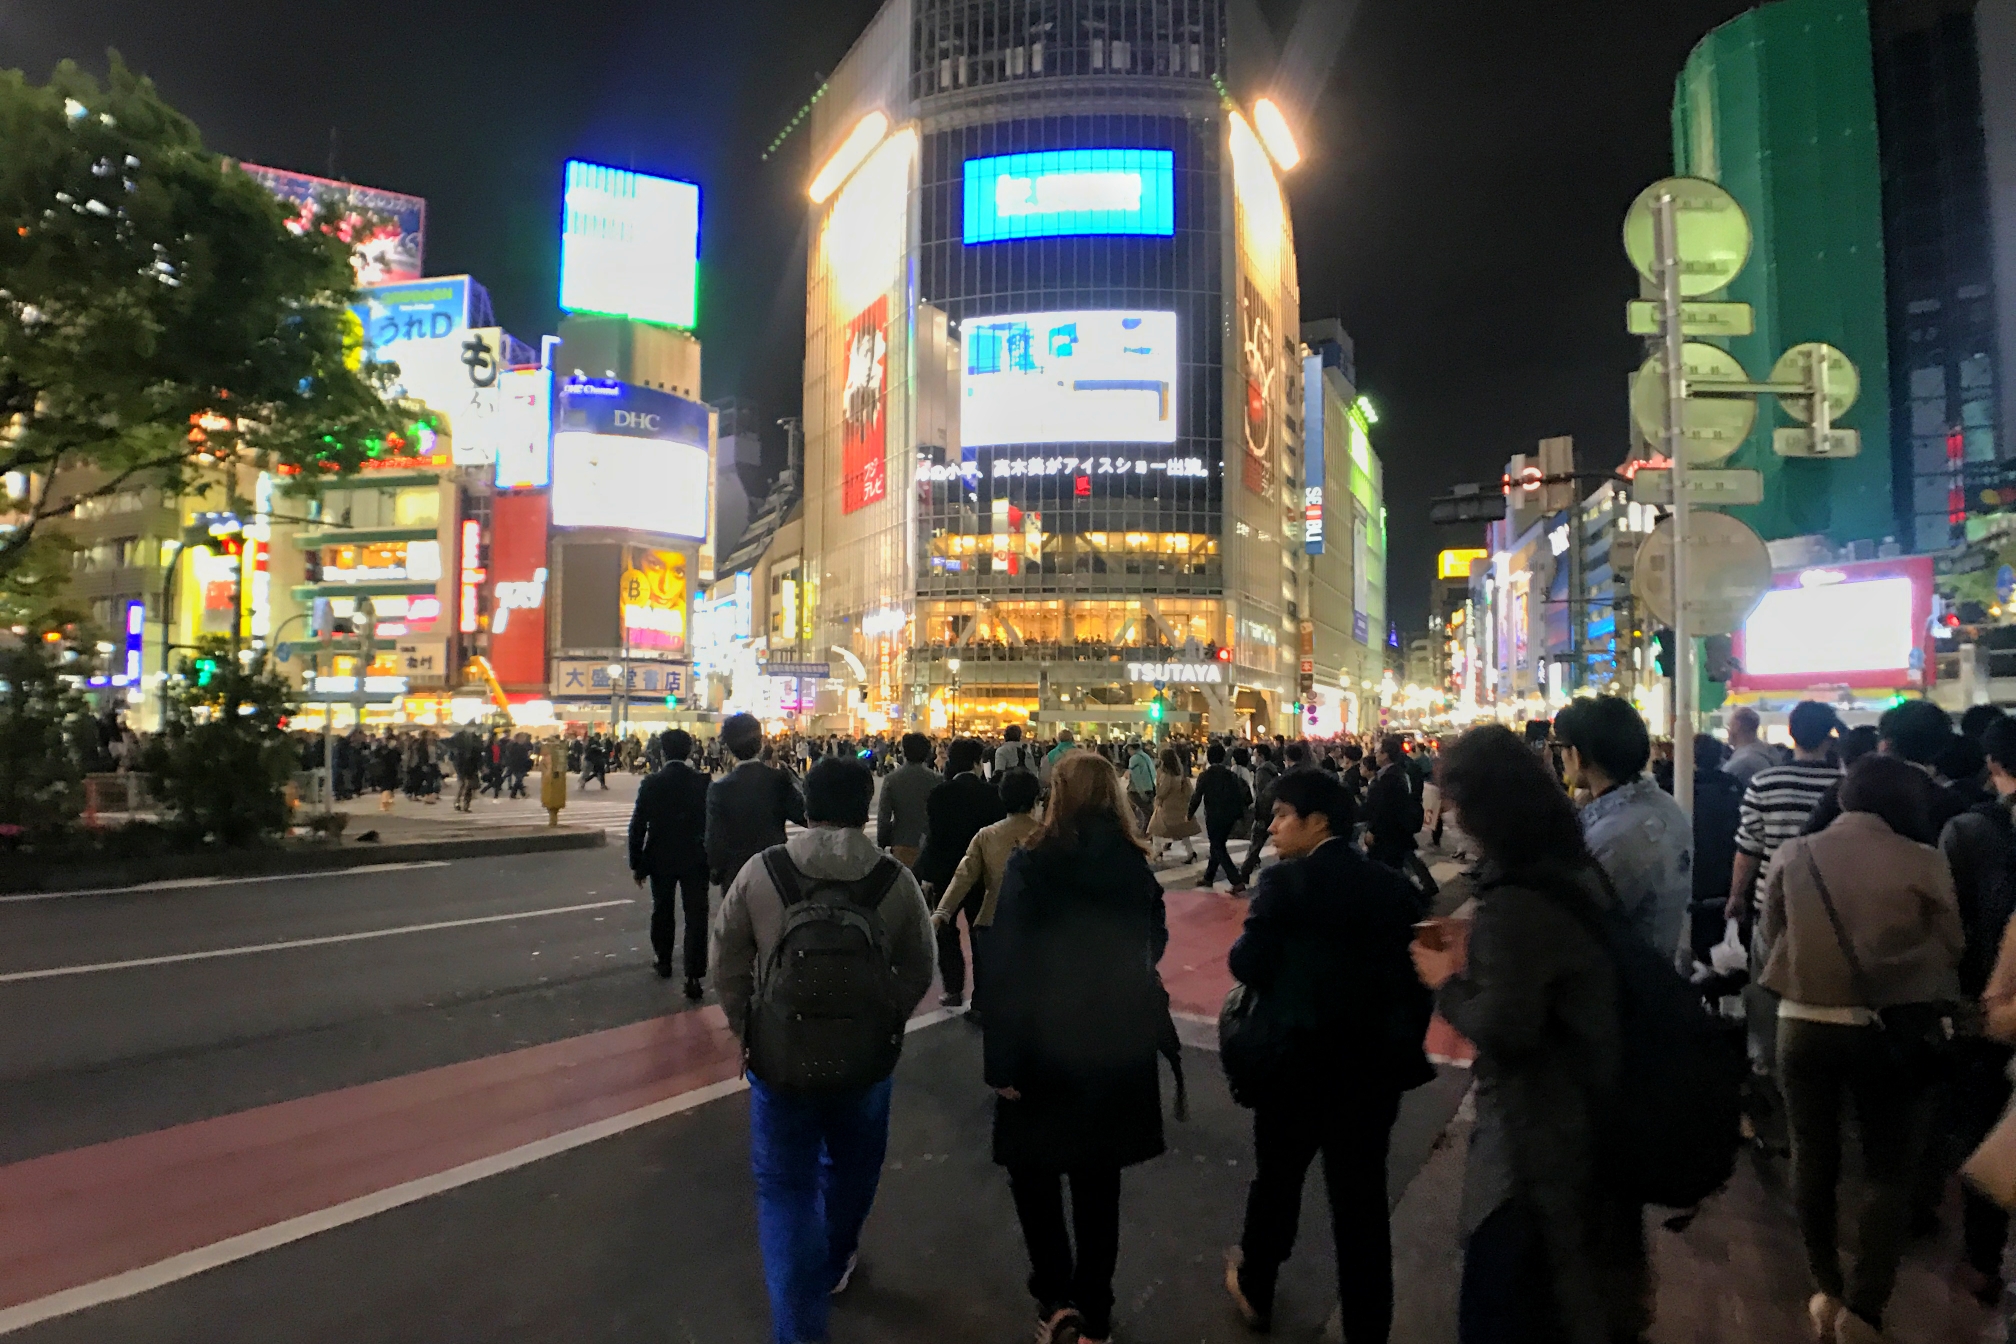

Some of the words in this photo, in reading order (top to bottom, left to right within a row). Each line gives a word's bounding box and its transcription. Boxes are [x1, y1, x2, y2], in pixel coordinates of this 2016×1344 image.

[614, 409, 660, 431] DHC
[863, 457, 878, 481] フジ
[863, 474, 884, 502] テレビ
[1305, 486, 1322, 541] SEIBU
[565, 667, 681, 692] 大盛堂書店
[1127, 663, 1221, 682] TSUTAYA
